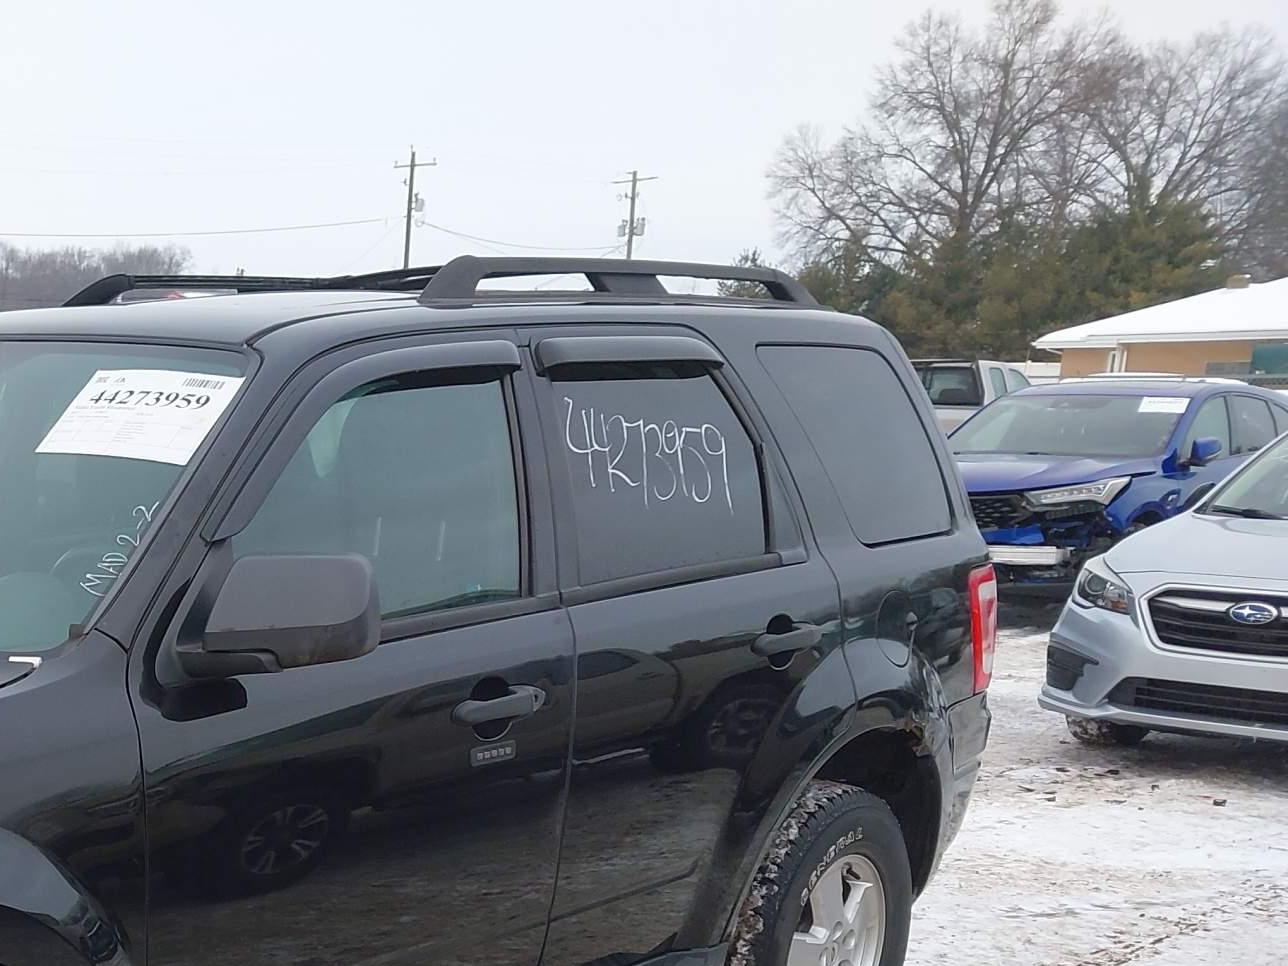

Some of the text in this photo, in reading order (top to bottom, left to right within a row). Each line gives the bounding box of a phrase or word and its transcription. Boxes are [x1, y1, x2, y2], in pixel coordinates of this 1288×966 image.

[90, 390, 210, 410] 44273959
[564, 397, 734, 515] 44273959
[80, 552, 128, 597] MAD
[800, 827, 864, 906] GENERAL
